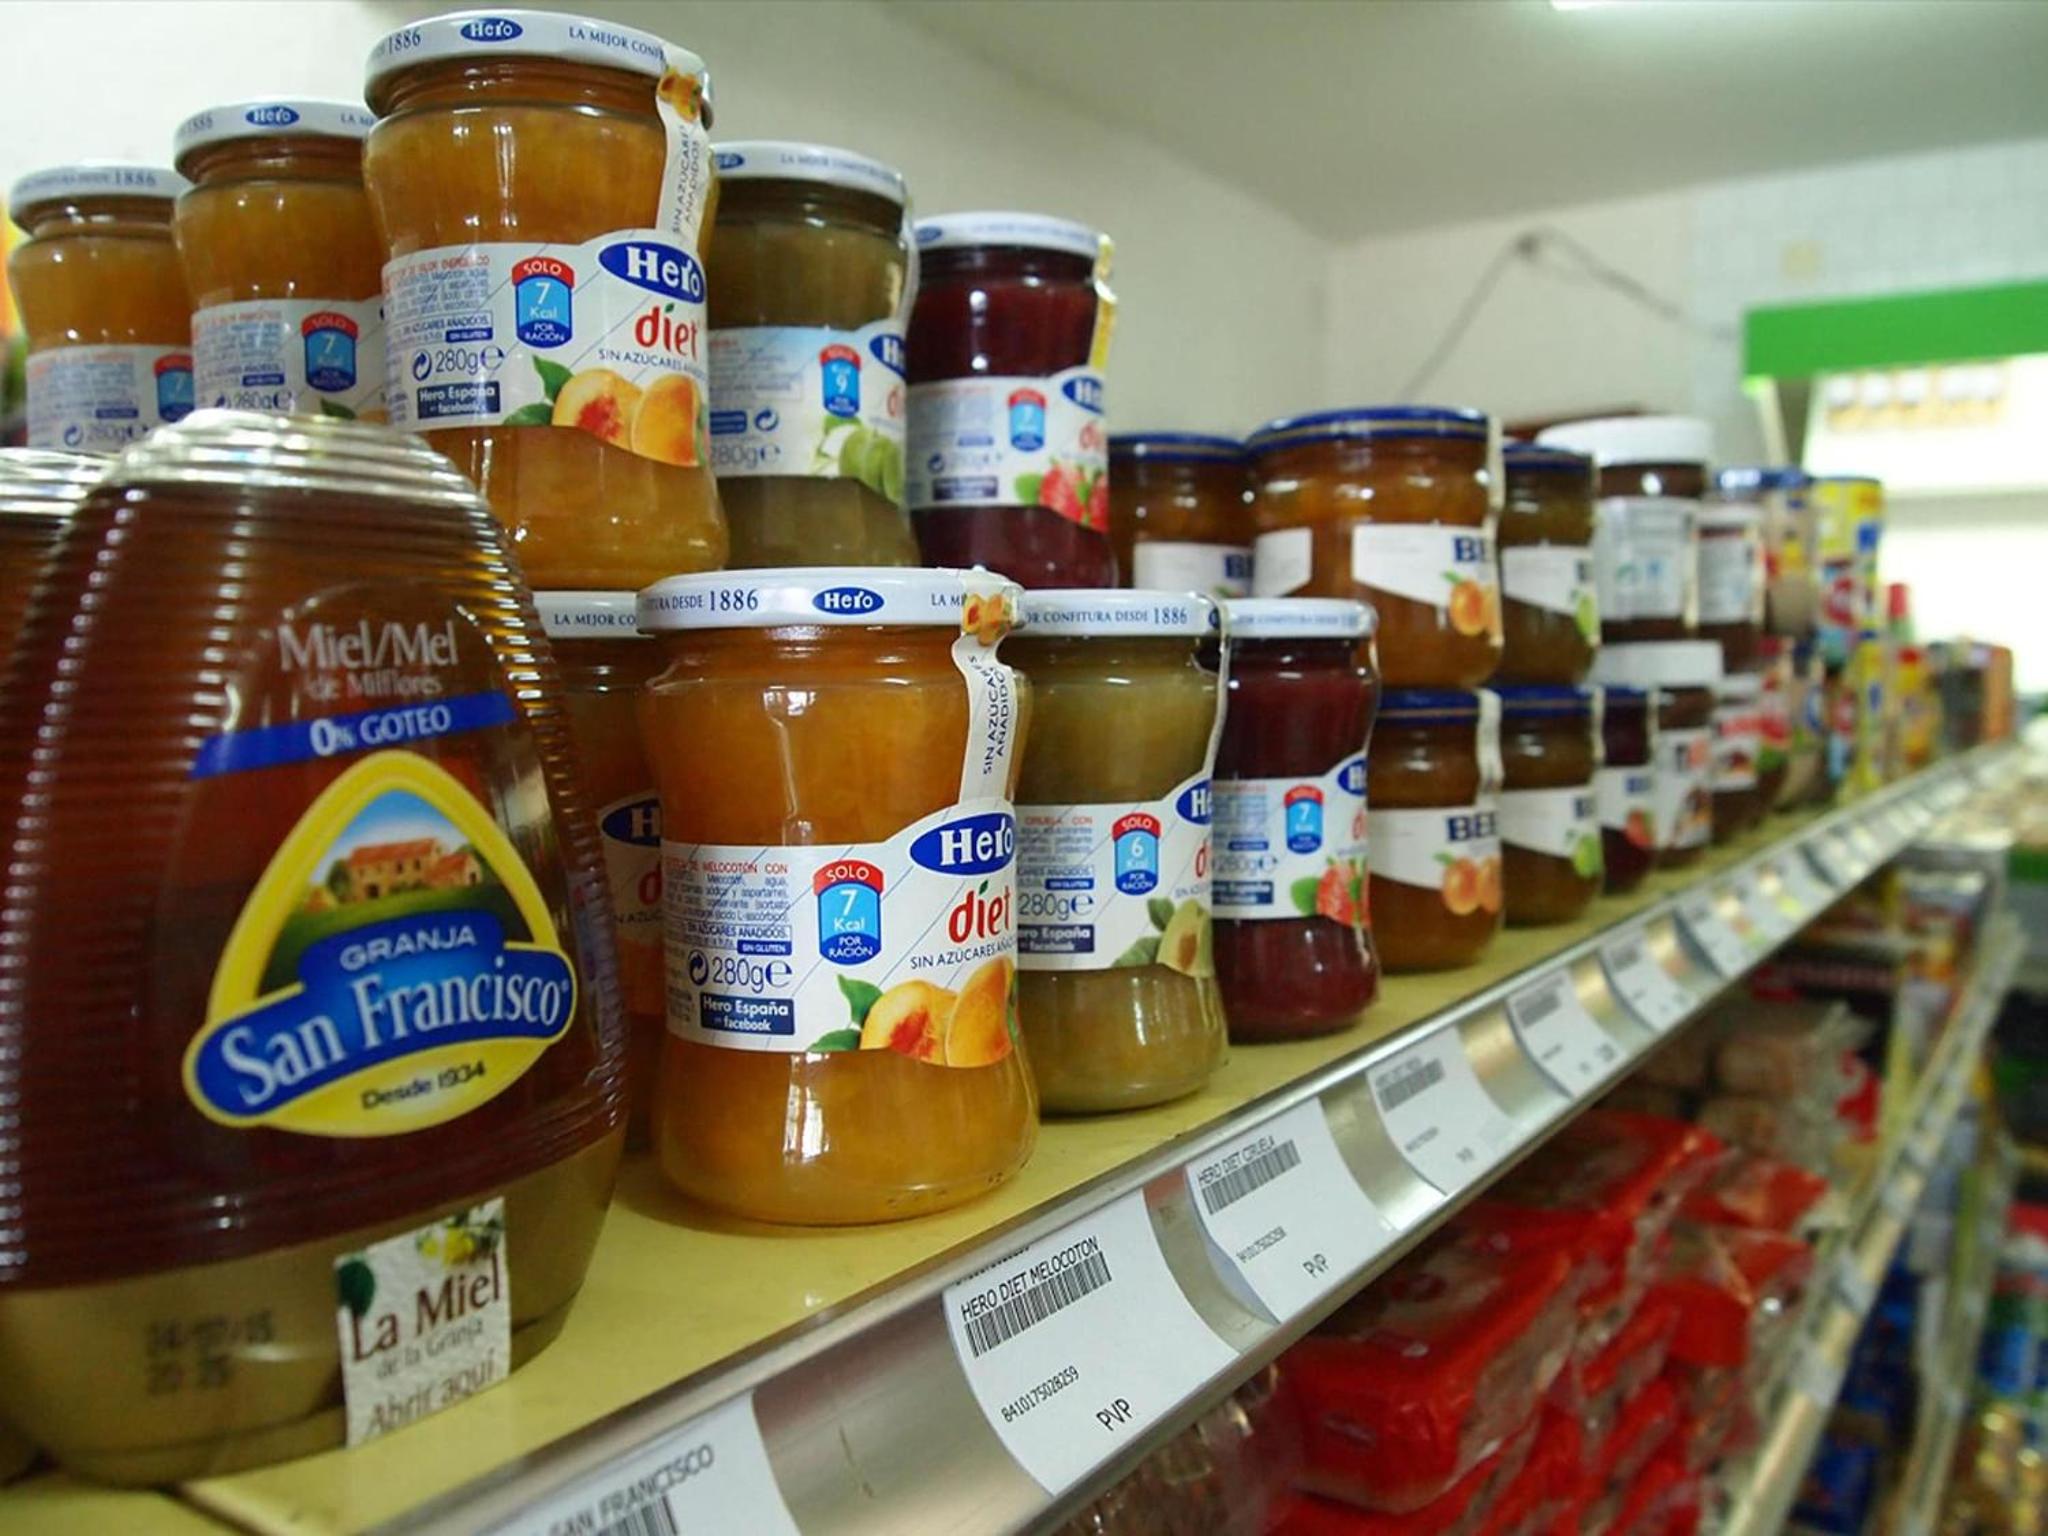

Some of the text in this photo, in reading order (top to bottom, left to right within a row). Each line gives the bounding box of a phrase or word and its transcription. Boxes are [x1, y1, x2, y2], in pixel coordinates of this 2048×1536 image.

[471, 21, 513, 37] Hero
[569, 27, 585, 39] LA
[590, 31, 628, 48] MEJOR
[254, 108, 291, 123] Hero
[673, 207, 683, 233] SIN
[523, 261, 563, 275] SOLO
[627, 246, 701, 297] Hero
[534, 282, 552, 304] 7
[529, 307, 558, 319] Kcal
[534, 323, 555, 332] POR
[635, 303, 698, 362] diet
[324, 335, 336, 354] 7
[598, 349, 621, 361] SIN
[420, 390, 445, 402] Hero
[672, 595, 703, 609] DESDE
[709, 589, 759, 611] 1886
[824, 591, 873, 609] Hero
[931, 593, 945, 606] LA
[554, 613, 569, 625] LA
[575, 614, 615, 626] MEJOR
[1043, 611, 1111, 623] CONFITURA
[1114, 611, 1148, 622] DESDE
[1153, 607, 1187, 625] 1886
[276, 619, 459, 671] Miel/Mel
[310, 705, 452, 757] 0% GOTEO
[983, 747, 995, 775] SIN
[1122, 816, 1152, 830] SOLO
[940, 817, 1014, 866] Hero
[1130, 837, 1144, 857] 6
[765, 862, 788, 874] CON
[826, 865, 869, 882] SOLO
[839, 889, 857, 916] 7
[949, 880, 1011, 944] diet
[834, 917, 865, 932] Kcal
[339, 926, 478, 971] GRANJA
[829, 945, 874, 958] RACIÓN
[839, 936, 862, 946] POR
[911, 955, 934, 970] SIN
[703, 996, 732, 1012] Hero
[735, 1000, 789, 1018] España
[220, 956, 562, 1106] San Francisco
[724, 1016, 772, 1031] facebook
[360, 1060, 487, 1111] Desde 1934
[1303, 1253, 1330, 1279] PVP
[960, 1289, 998, 1322] HERO
[998, 1271, 1028, 1302] DIET
[1029, 1235, 1100, 1284] MELOCOTON
[415, 1252, 500, 1337] Miel
[426, 1319, 484, 1357] Granja
[367, 1347, 496, 1436] Abrir aquí
[1001, 1364, 1080, 1423] 8410175028259
[1096, 1397, 1133, 1432] PVP
[598, 1443, 716, 1521] FRANCISCO
